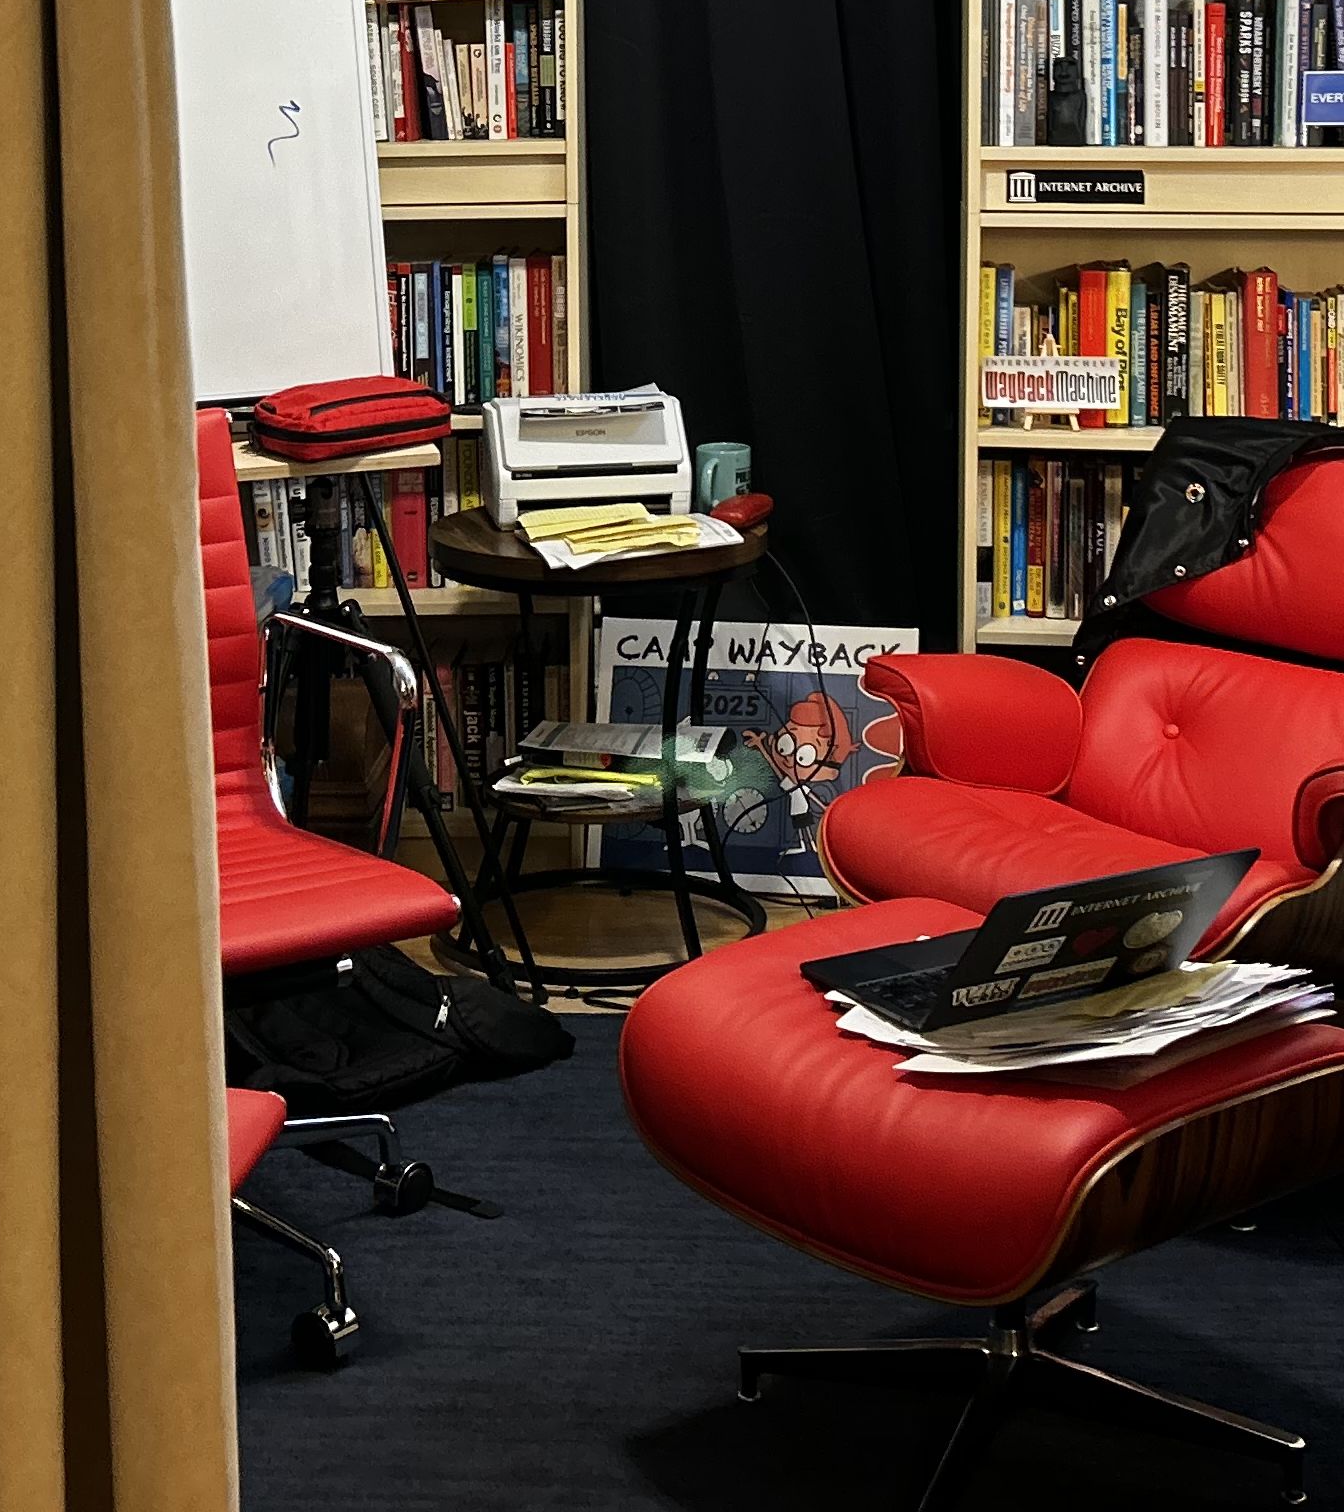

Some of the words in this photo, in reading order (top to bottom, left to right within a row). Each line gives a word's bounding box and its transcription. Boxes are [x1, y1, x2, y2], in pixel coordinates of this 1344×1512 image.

[1071, 23, 1079, 45] MINDS
[1239, 11, 1252, 54] SPARKS
[1252, 17, 1262, 45] NOAM
[1252, 48, 1263, 95] CHOMSKY
[1240, 70, 1250, 103] JOHNSON
[1039, 182, 1092, 193] INTERNET
[1094, 182, 1143, 193] ARCHIVE
[1178, 284, 1186, 301] THE
[443, 290, 452, 333] Imagining
[1111, 308, 1127, 337] Bay
[1150, 303, 1159, 335] ARMS
[1168, 275, 1178, 352] DISARMAMENT
[1178, 303, 1187, 331] GAME
[515, 314, 525, 381] WIKINOMICS
[1116, 339, 1128, 356] of
[1150, 338, 1159, 360] AND
[1178, 332, 1187, 344] OF
[985, 359, 1045, 368] INTERNET
[1050, 358, 1117, 368] ARCHIVE
[1150, 362, 1160, 417] INFLUENCE
[1096, 522, 1104, 555] PAUL
[701, 694, 760, 718] 2025
[463, 711, 482, 743] jack
[1071, 895, 1138, 917] INTERNET
